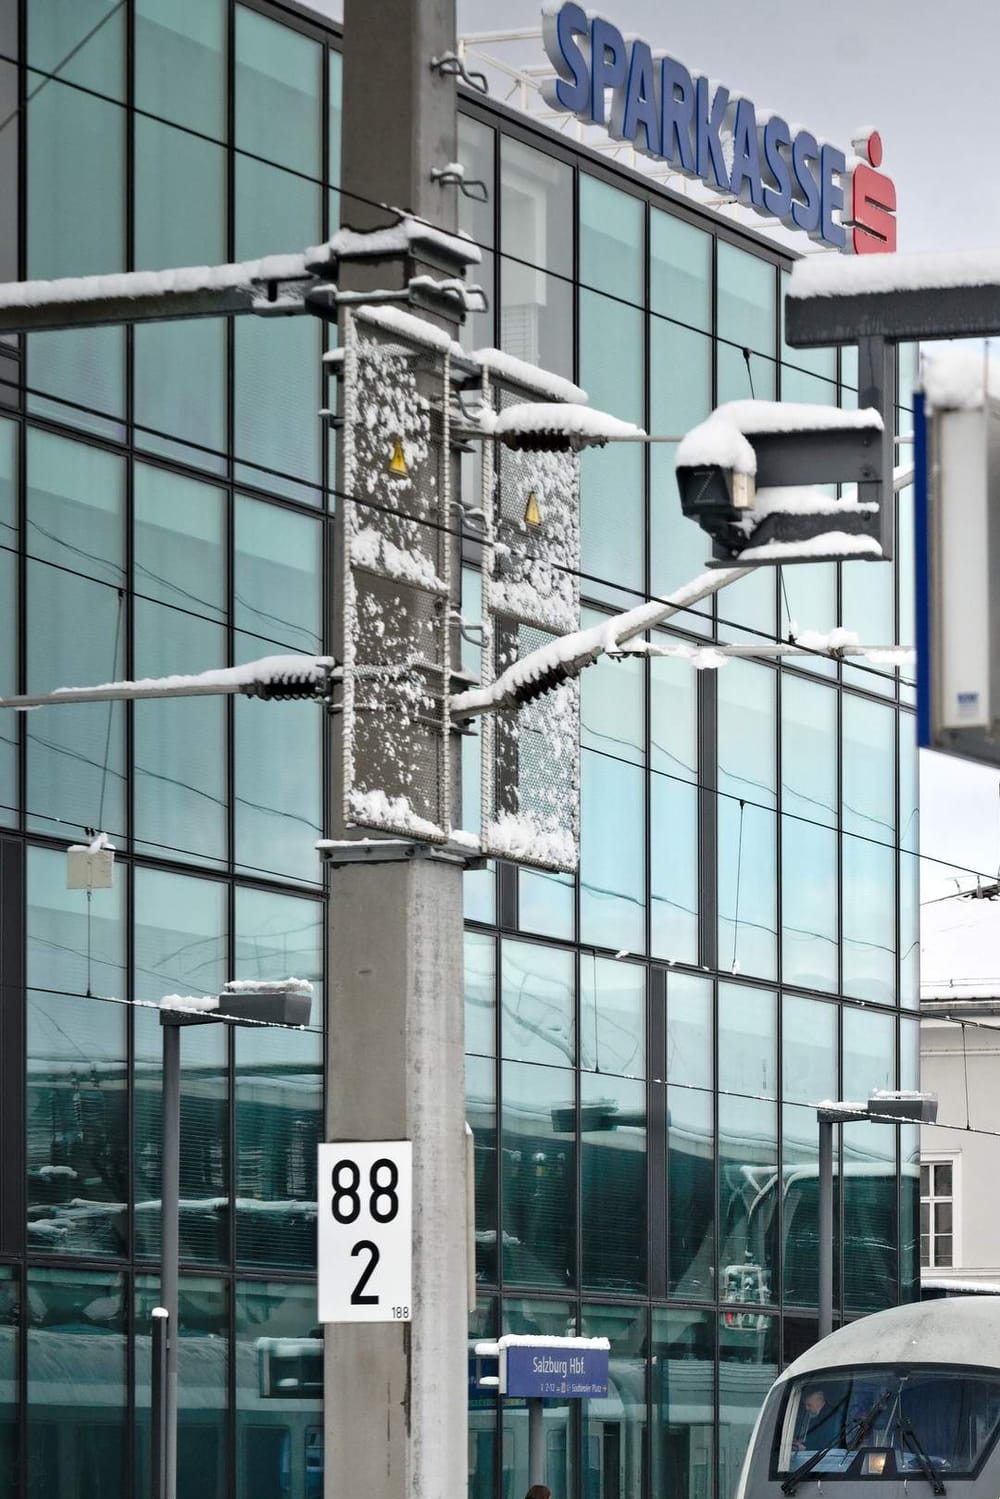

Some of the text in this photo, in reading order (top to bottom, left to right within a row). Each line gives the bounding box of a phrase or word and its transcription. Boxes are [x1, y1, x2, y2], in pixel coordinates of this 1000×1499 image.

[550, 1, 847, 250] SPARKASSE
[331, 1158, 399, 1225] 88
[350, 1239, 380, 1305] 2
[391, 1306, 409, 1319] 188
[532, 1356, 586, 1378] Salzburg Hbf.
